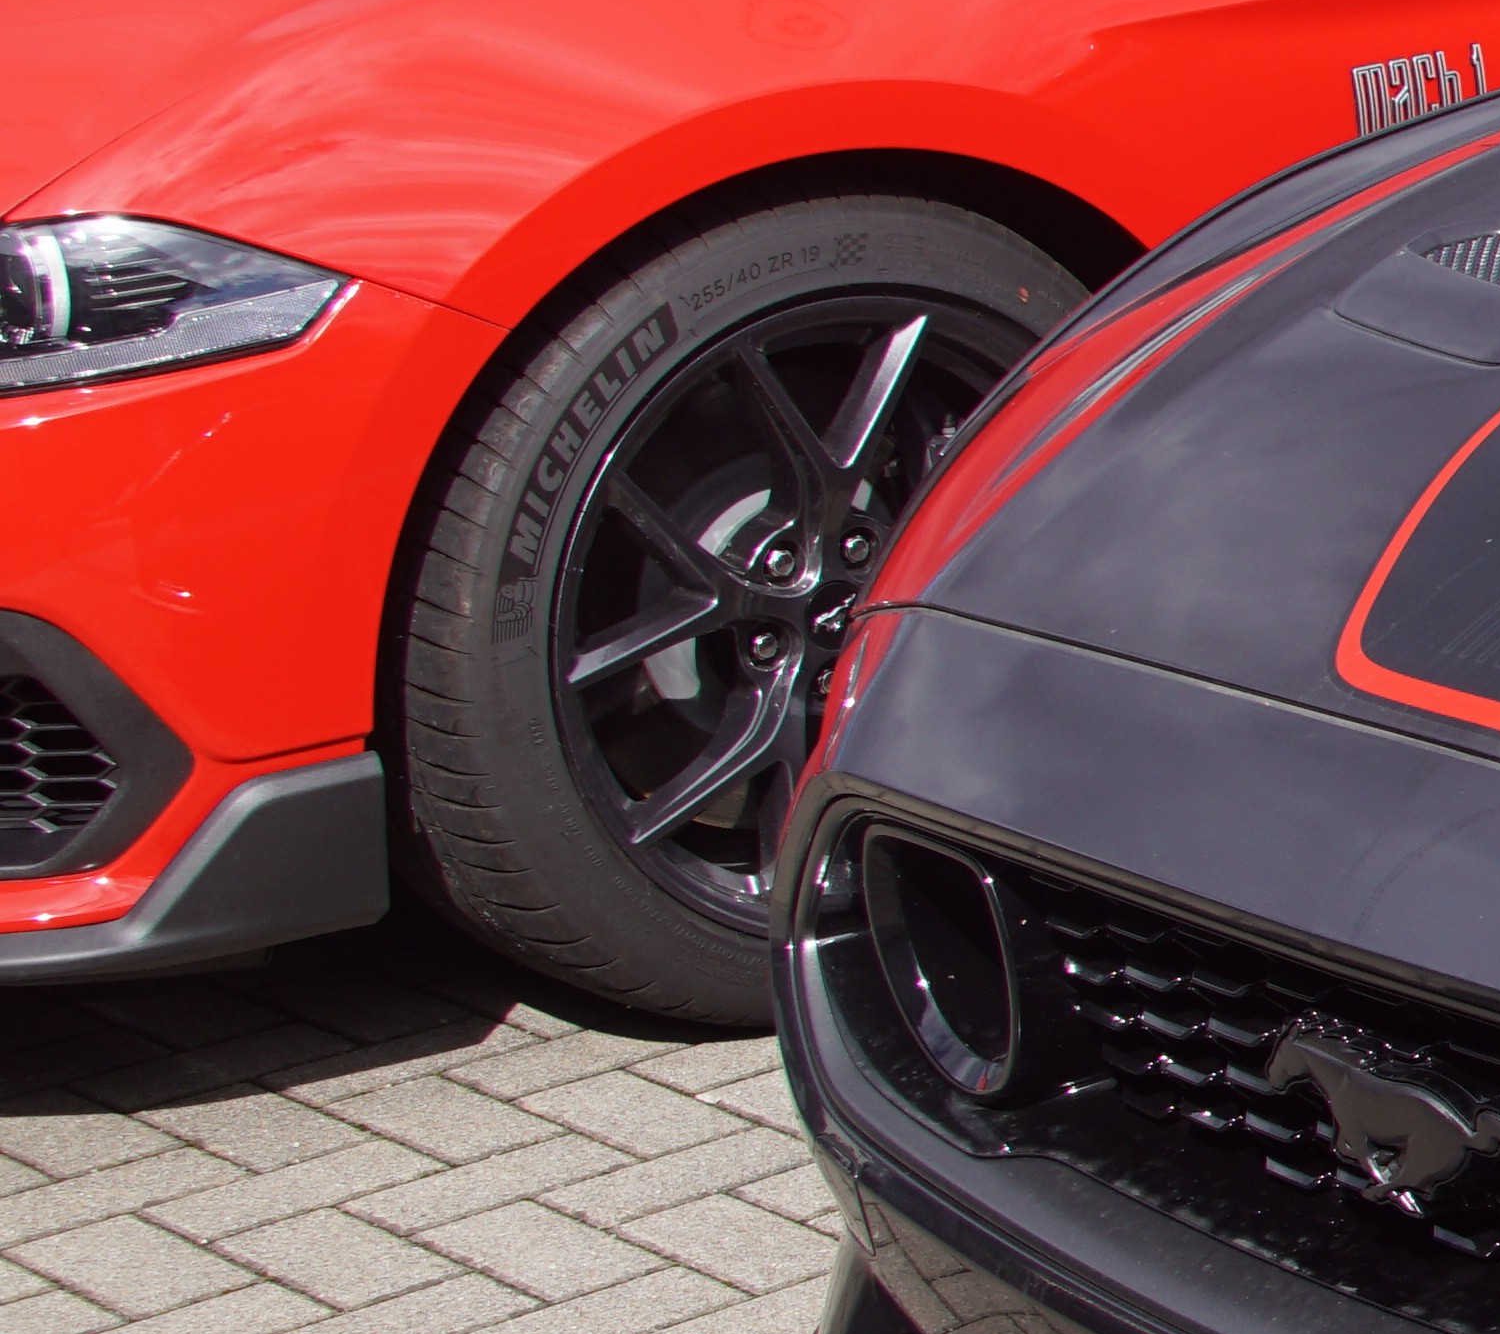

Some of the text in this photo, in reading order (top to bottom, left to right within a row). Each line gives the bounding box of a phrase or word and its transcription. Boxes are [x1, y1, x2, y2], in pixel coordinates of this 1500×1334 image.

[1470, 43, 1487, 96] 1
[691, 244, 821, 312] 255/40 ZR 19
[509, 318, 666, 566] MICHELIN
